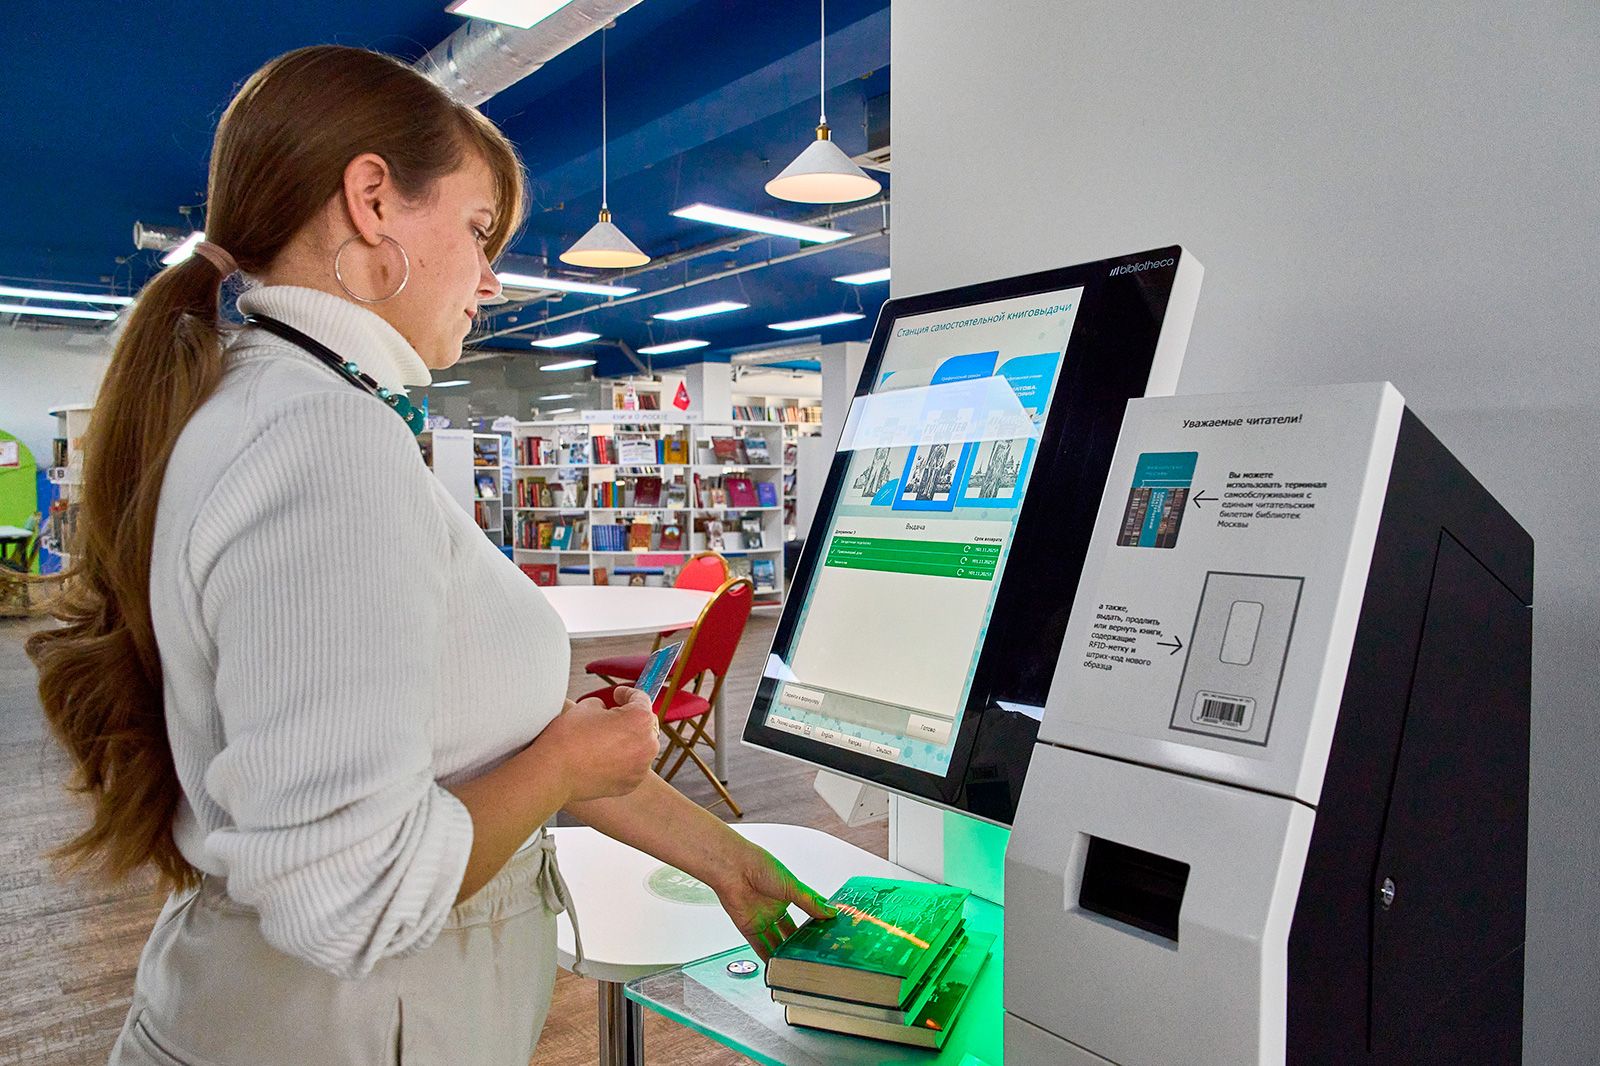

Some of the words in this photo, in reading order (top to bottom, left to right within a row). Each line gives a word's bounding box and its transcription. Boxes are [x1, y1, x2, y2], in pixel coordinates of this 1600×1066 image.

[1119, 258, 1174, 275] bibliotheca
[897, 325, 929, 338] Станция
[930, 312, 1005, 333] самостоятельной
[1007, 303, 1072, 320] книговыдачи
[1182, 417, 1243, 429] Уважаемые
[1246, 414, 1303, 425] читатели!
[1229, 471, 1240, 479] Вы
[1226, 481, 1282, 489] использовать
[1285, 482, 1328, 490] терминал
[1224, 491, 1304, 500] самообслуживания
[1255, 501, 1315, 509] читательским
[1219, 510, 1253, 518] билетом
[1255, 510, 1301, 519] библиотек
[1217, 520, 1249, 528] Москвы
[1105, 604, 1129, 613] также,
[1096, 613, 1124, 623] выдать,
[1125, 616, 1160, 626] продлить
[1108, 625, 1137, 634] вернуть
[1139, 629, 1163, 637] книги,
[1091, 632, 1136, 643] содержащие
[1088, 641, 1129, 653] RFID-метку
[1086, 651, 1124, 663] штрих-код
[1125, 657, 1151, 666] нового
[1083, 661, 1112, 671] образца
